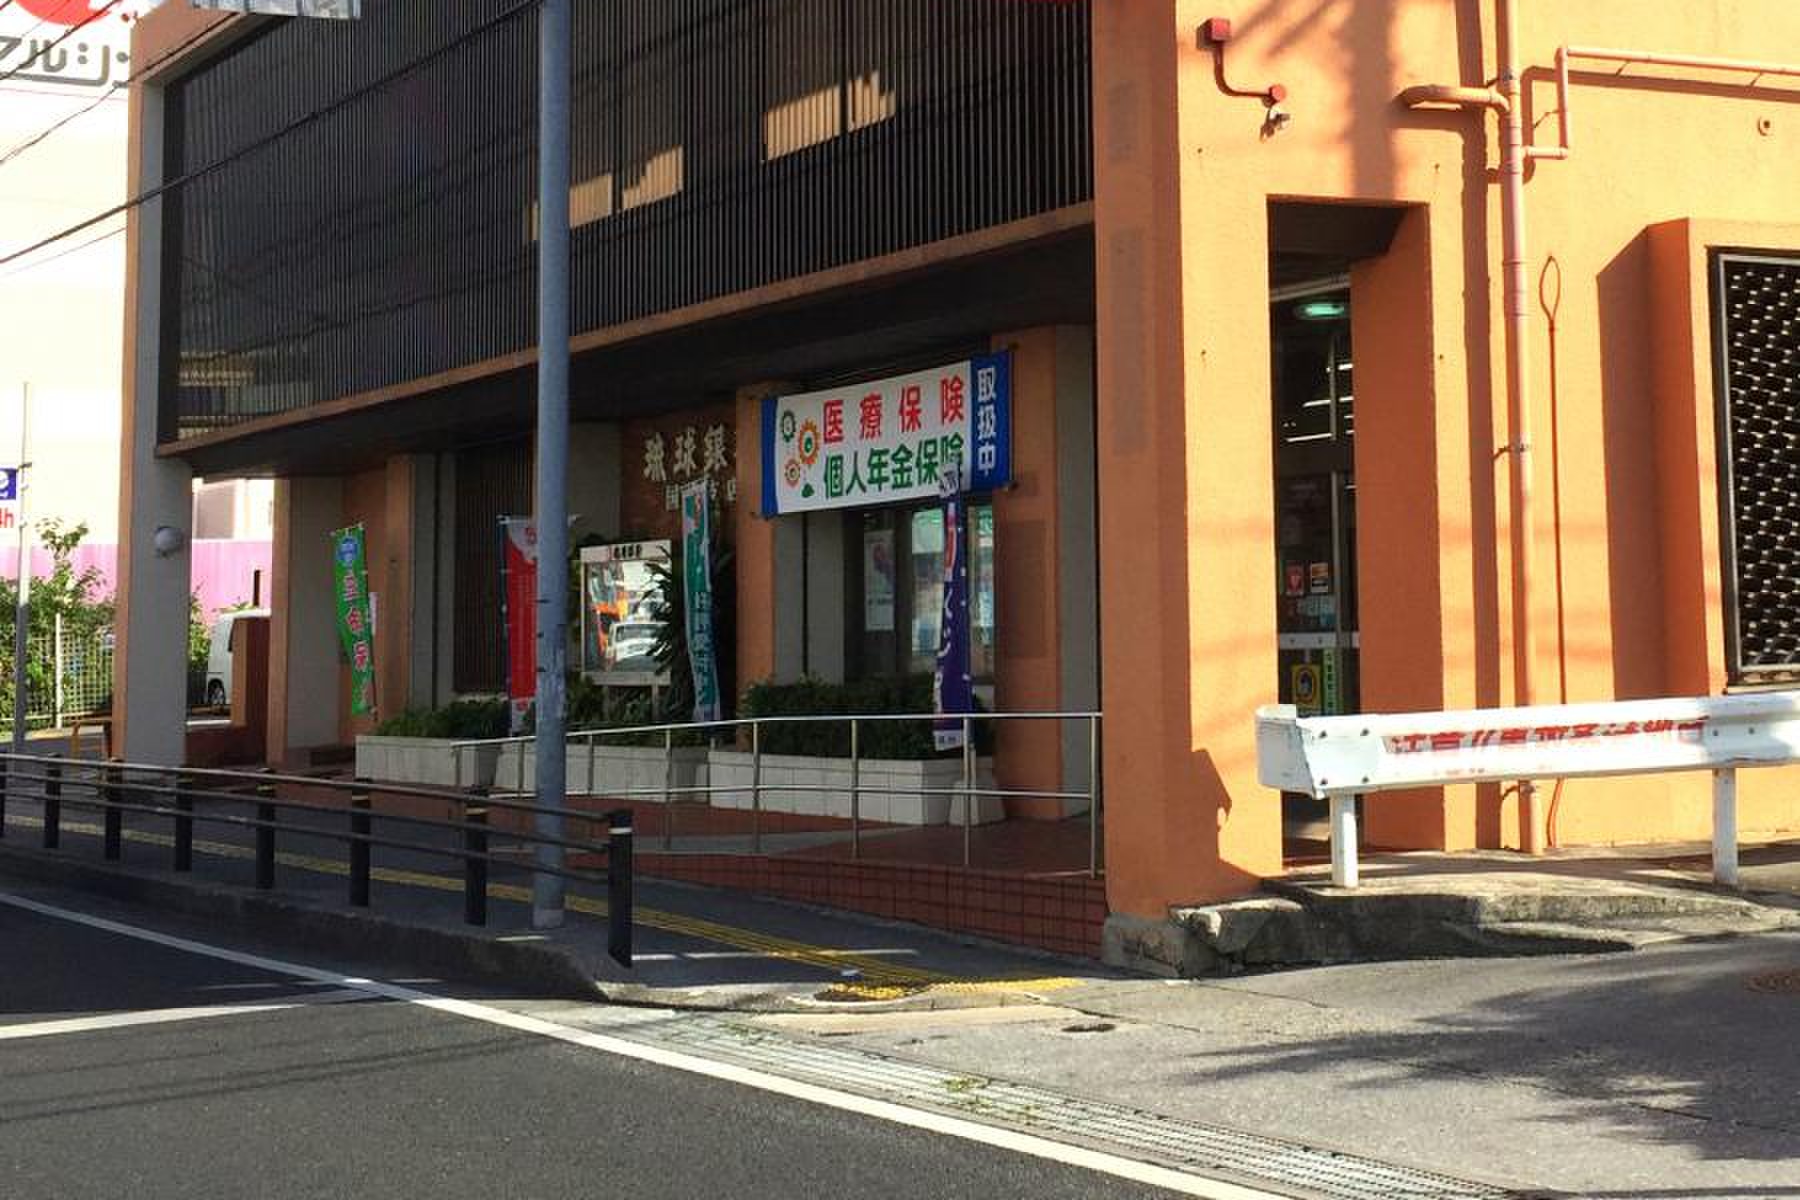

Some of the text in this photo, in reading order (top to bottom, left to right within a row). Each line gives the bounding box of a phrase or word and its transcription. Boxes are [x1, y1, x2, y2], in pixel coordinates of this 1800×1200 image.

[823, 376, 965, 445] 医療保険
[976, 367, 997, 477] 取扱中
[643, 424, 736, 481] 琉球銀
[823, 432, 965, 499] 個人年金保険
